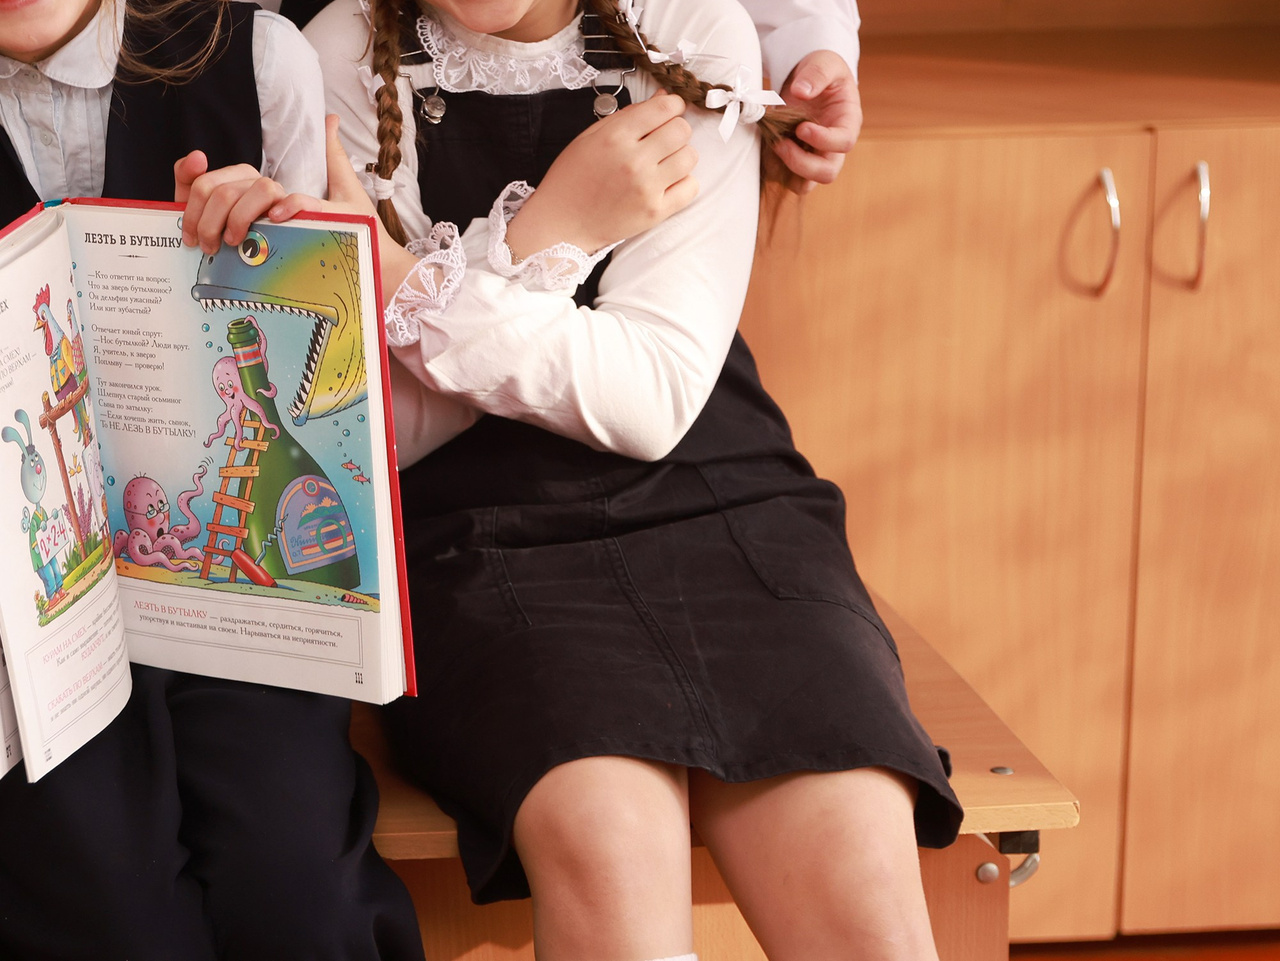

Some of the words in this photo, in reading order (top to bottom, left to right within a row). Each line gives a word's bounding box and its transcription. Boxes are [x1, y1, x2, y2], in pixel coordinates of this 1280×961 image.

[85, 233, 116, 244] ЛЕЗТЬ
[120, 235, 126, 245] В
[130, 235, 182, 248] БУТЫЛКУ
[88, 281, 100, 289] Что
[89, 292, 99, 300] Он
[101, 294, 128, 303] дельфин
[89, 302, 103, 310] Или
[91, 324, 120, 334] Отвечает
[115, 337, 149, 346] бутылкой?
[151, 340, 171, 349] Люди
[94, 356, 122, 368] Поплыву
[134, 362, 165, 371] проверю!
[96, 377, 107, 387] Тут
[109, 382, 143, 390] закончился
[97, 388, 126, 400] Шлепнул
[128, 394, 150, 402] старый
[98, 399, 115, 408] Сына
[124, 415, 146, 423] хочешь
[100, 420, 108, 428] То
[109, 422, 120, 430] НЕ
[122, 423, 143, 433] ЛЕЗЬ
[145, 426, 150, 434] В
[153, 426, 196, 438] БУТЫЛКУ!
[134, 601, 159, 612] ЛЕЗТЬ
[161, 605, 166, 613] В
[168, 606, 207, 618] БУТЫЛКУ
[139, 614, 169, 625] упорствуя
[176, 621, 207, 630] настаивая
[240, 627, 281, 639] Нарываться
[292, 636, 338, 648] неприятности.
